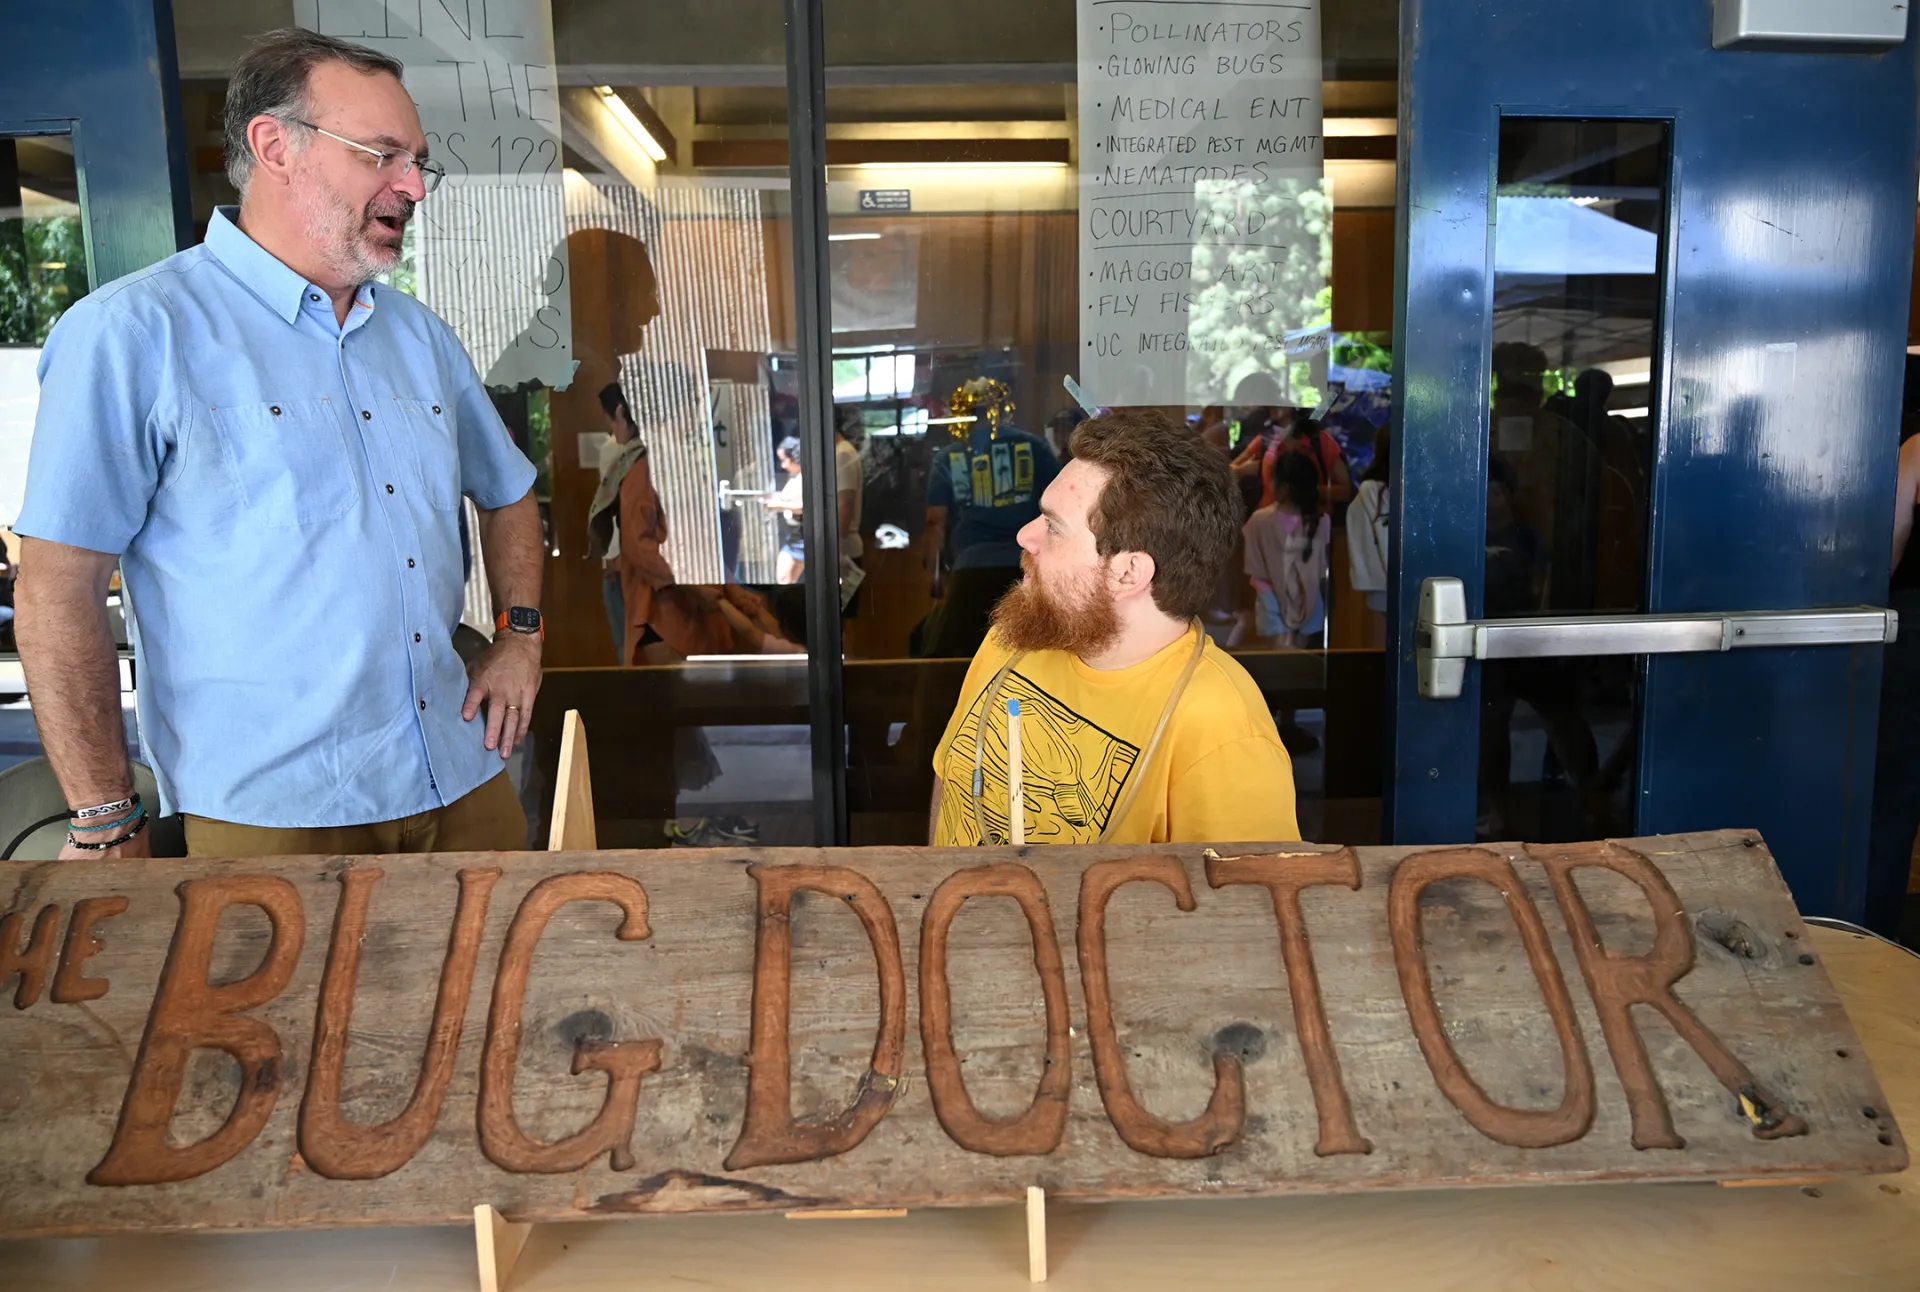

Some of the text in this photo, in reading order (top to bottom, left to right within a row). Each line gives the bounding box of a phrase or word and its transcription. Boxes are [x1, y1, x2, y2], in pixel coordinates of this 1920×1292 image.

[1110, 12, 1303, 44] POLLINATORS
[1107, 54, 1283, 77] GLOWING BUGS
[436, 59, 553, 123] THE
[1110, 95, 1310, 122] MEDICAL ENT
[1106, 135, 1320, 154] INTEGRATED PEST MGMT
[491, 135, 560, 195] 122
[1104, 161, 1268, 186] NEMATODES
[1091, 208, 1266, 239] COURTYARD
[1099, 260, 1286, 283] MAGGOT ART
[1099, 291, 1275, 316] FLY FISRS
[1095, 333, 1122, 356] UC
[84, 866, 666, 1186] BUG
[723, 841, 1810, 1172] DOCTOR
